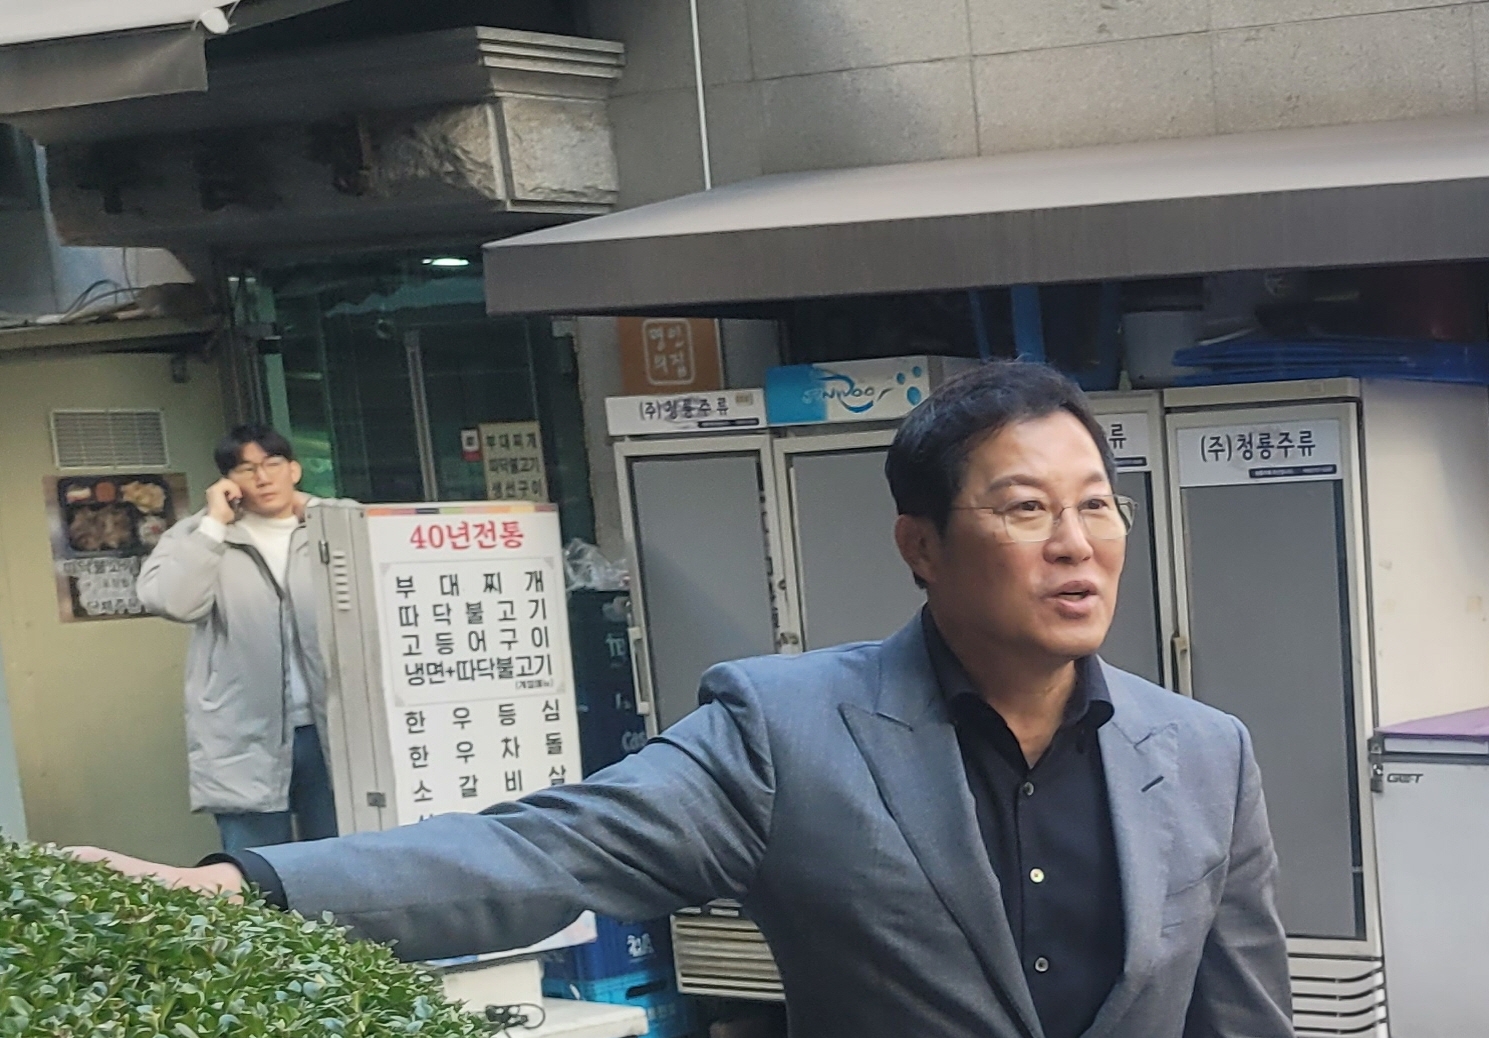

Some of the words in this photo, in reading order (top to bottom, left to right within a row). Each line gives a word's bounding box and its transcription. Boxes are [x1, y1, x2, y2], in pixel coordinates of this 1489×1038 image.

[1200, 430, 1316, 462] (주)청룡주류
[410, 520, 525, 550] 40년전통
[404, 654, 553, 687] 냉면+따닥불고기
